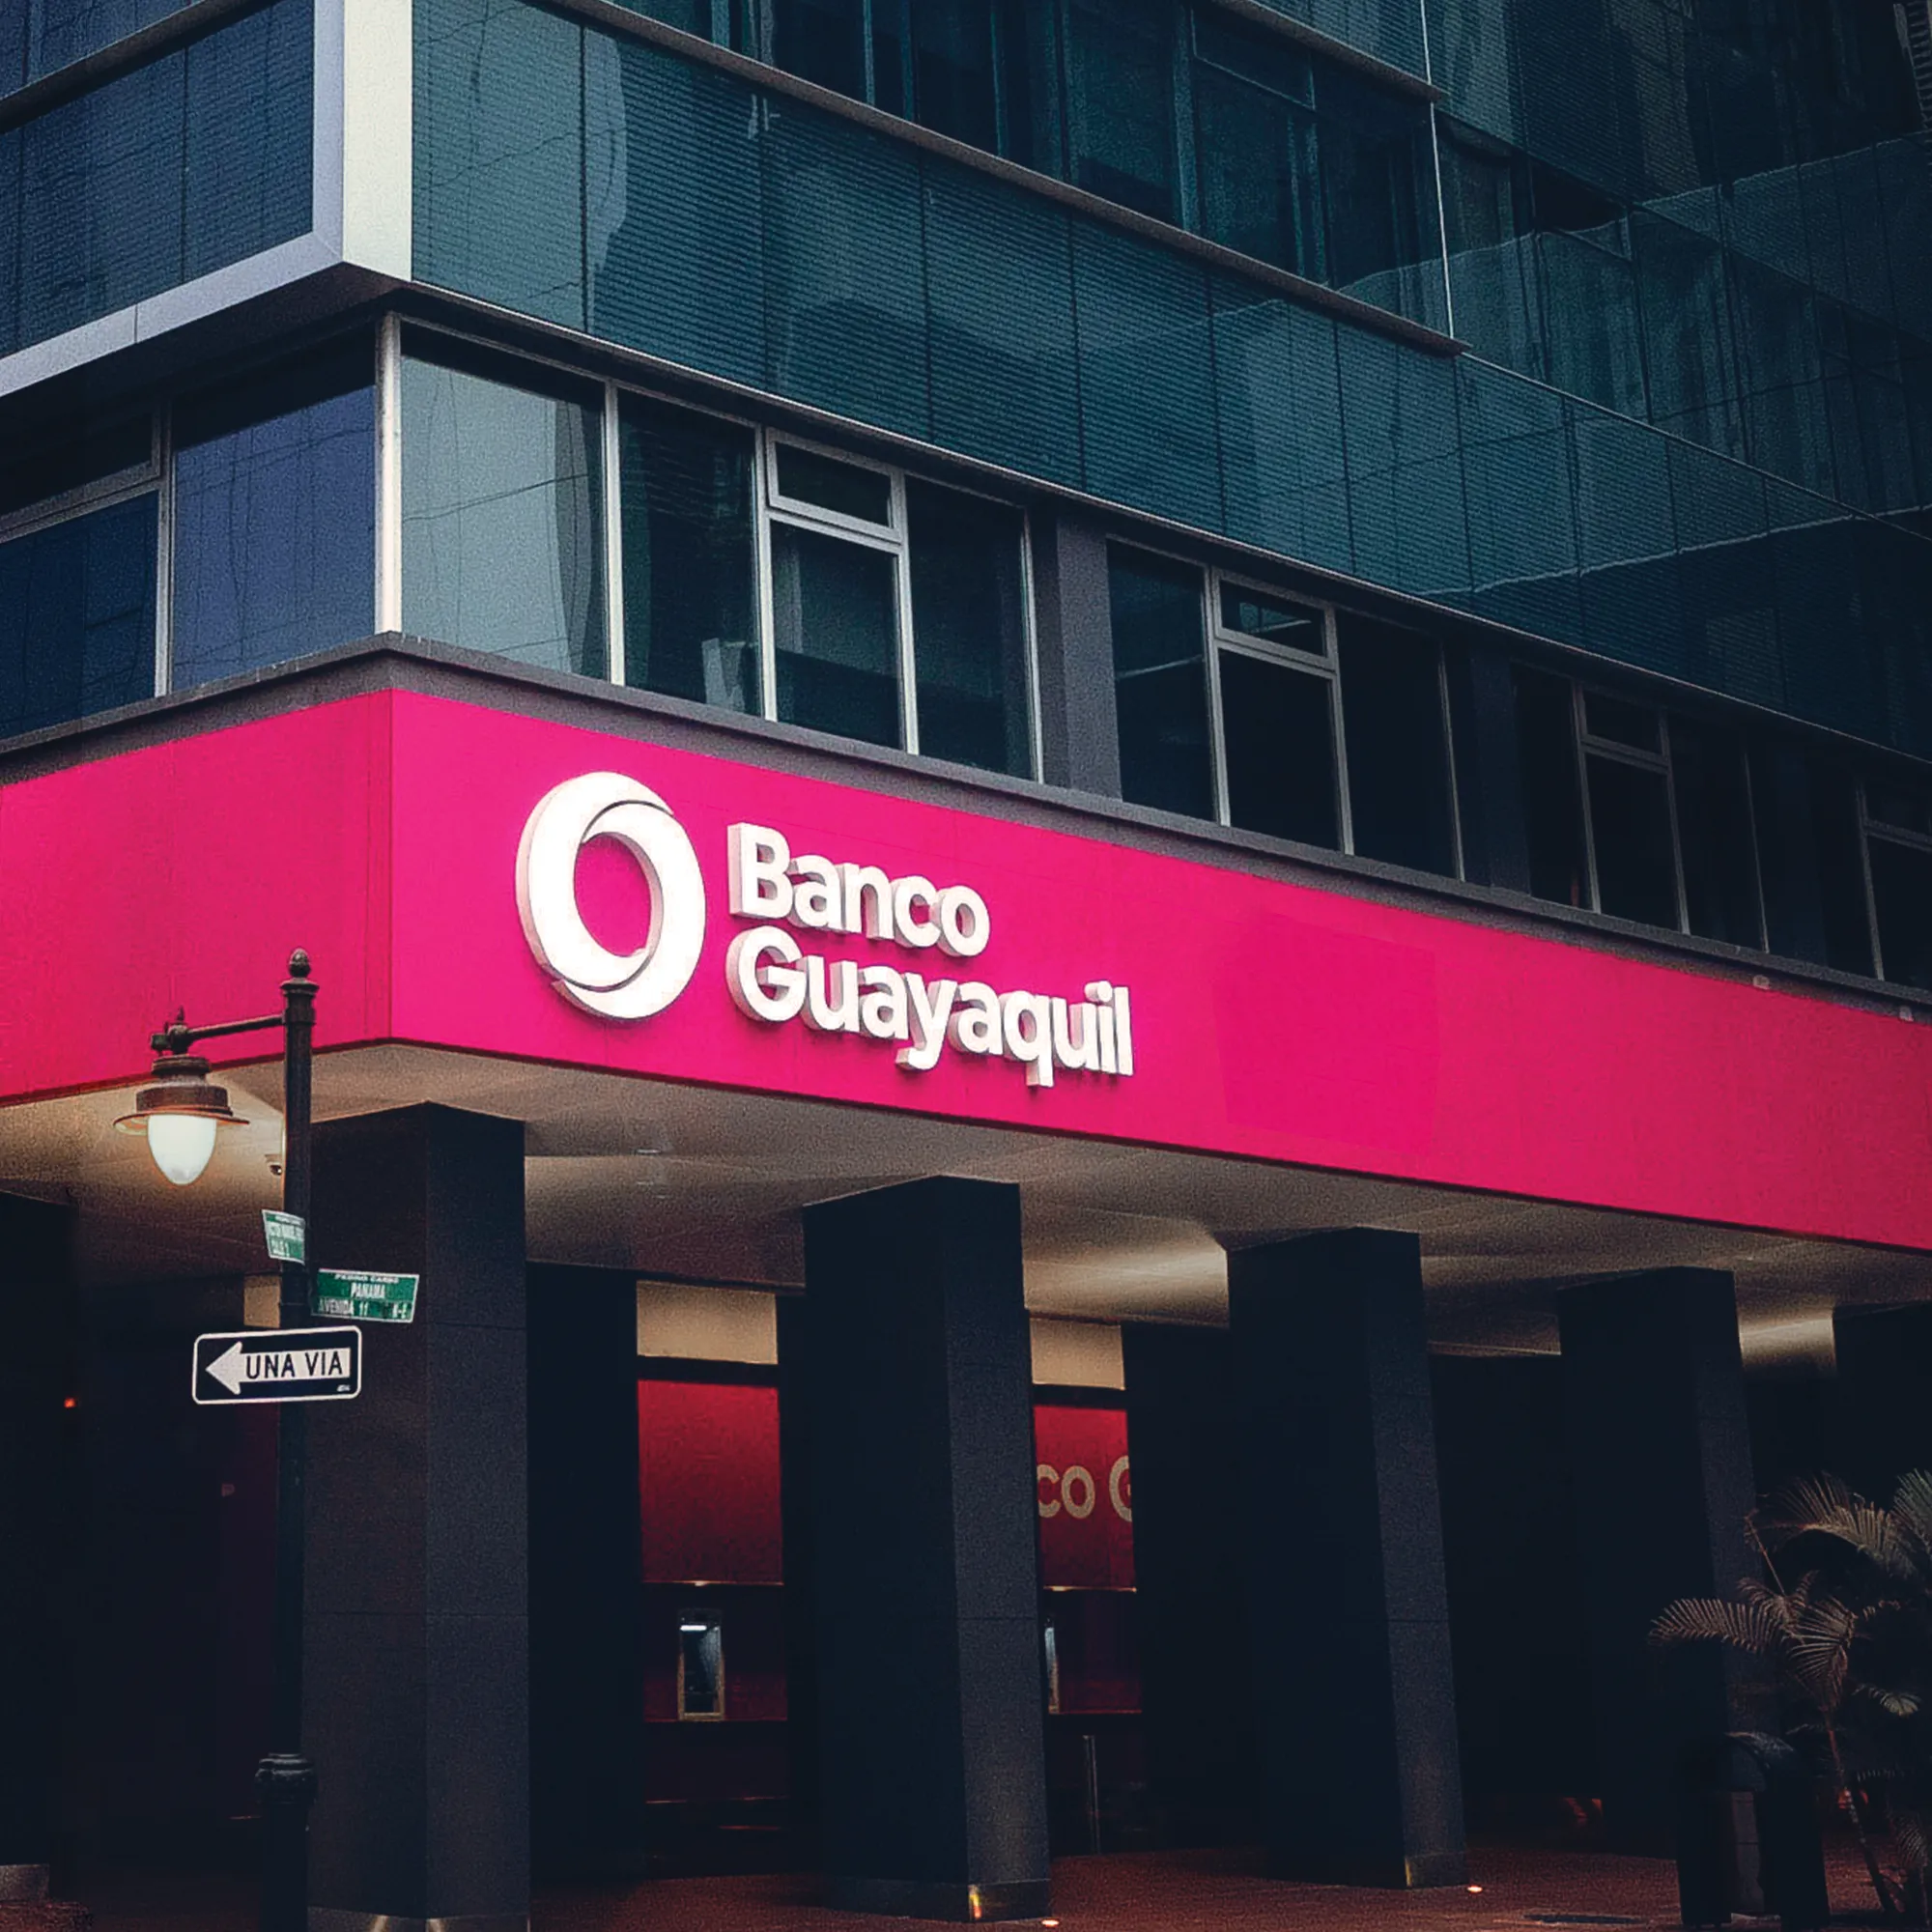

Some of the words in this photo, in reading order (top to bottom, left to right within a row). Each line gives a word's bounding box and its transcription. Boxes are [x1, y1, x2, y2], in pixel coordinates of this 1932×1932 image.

[727, 823, 989, 957] Banco
[725, 925, 1133, 1088] Guayaquil
[245, 1354, 296, 1379] UNA
[305, 1350, 342, 1377] VIA
